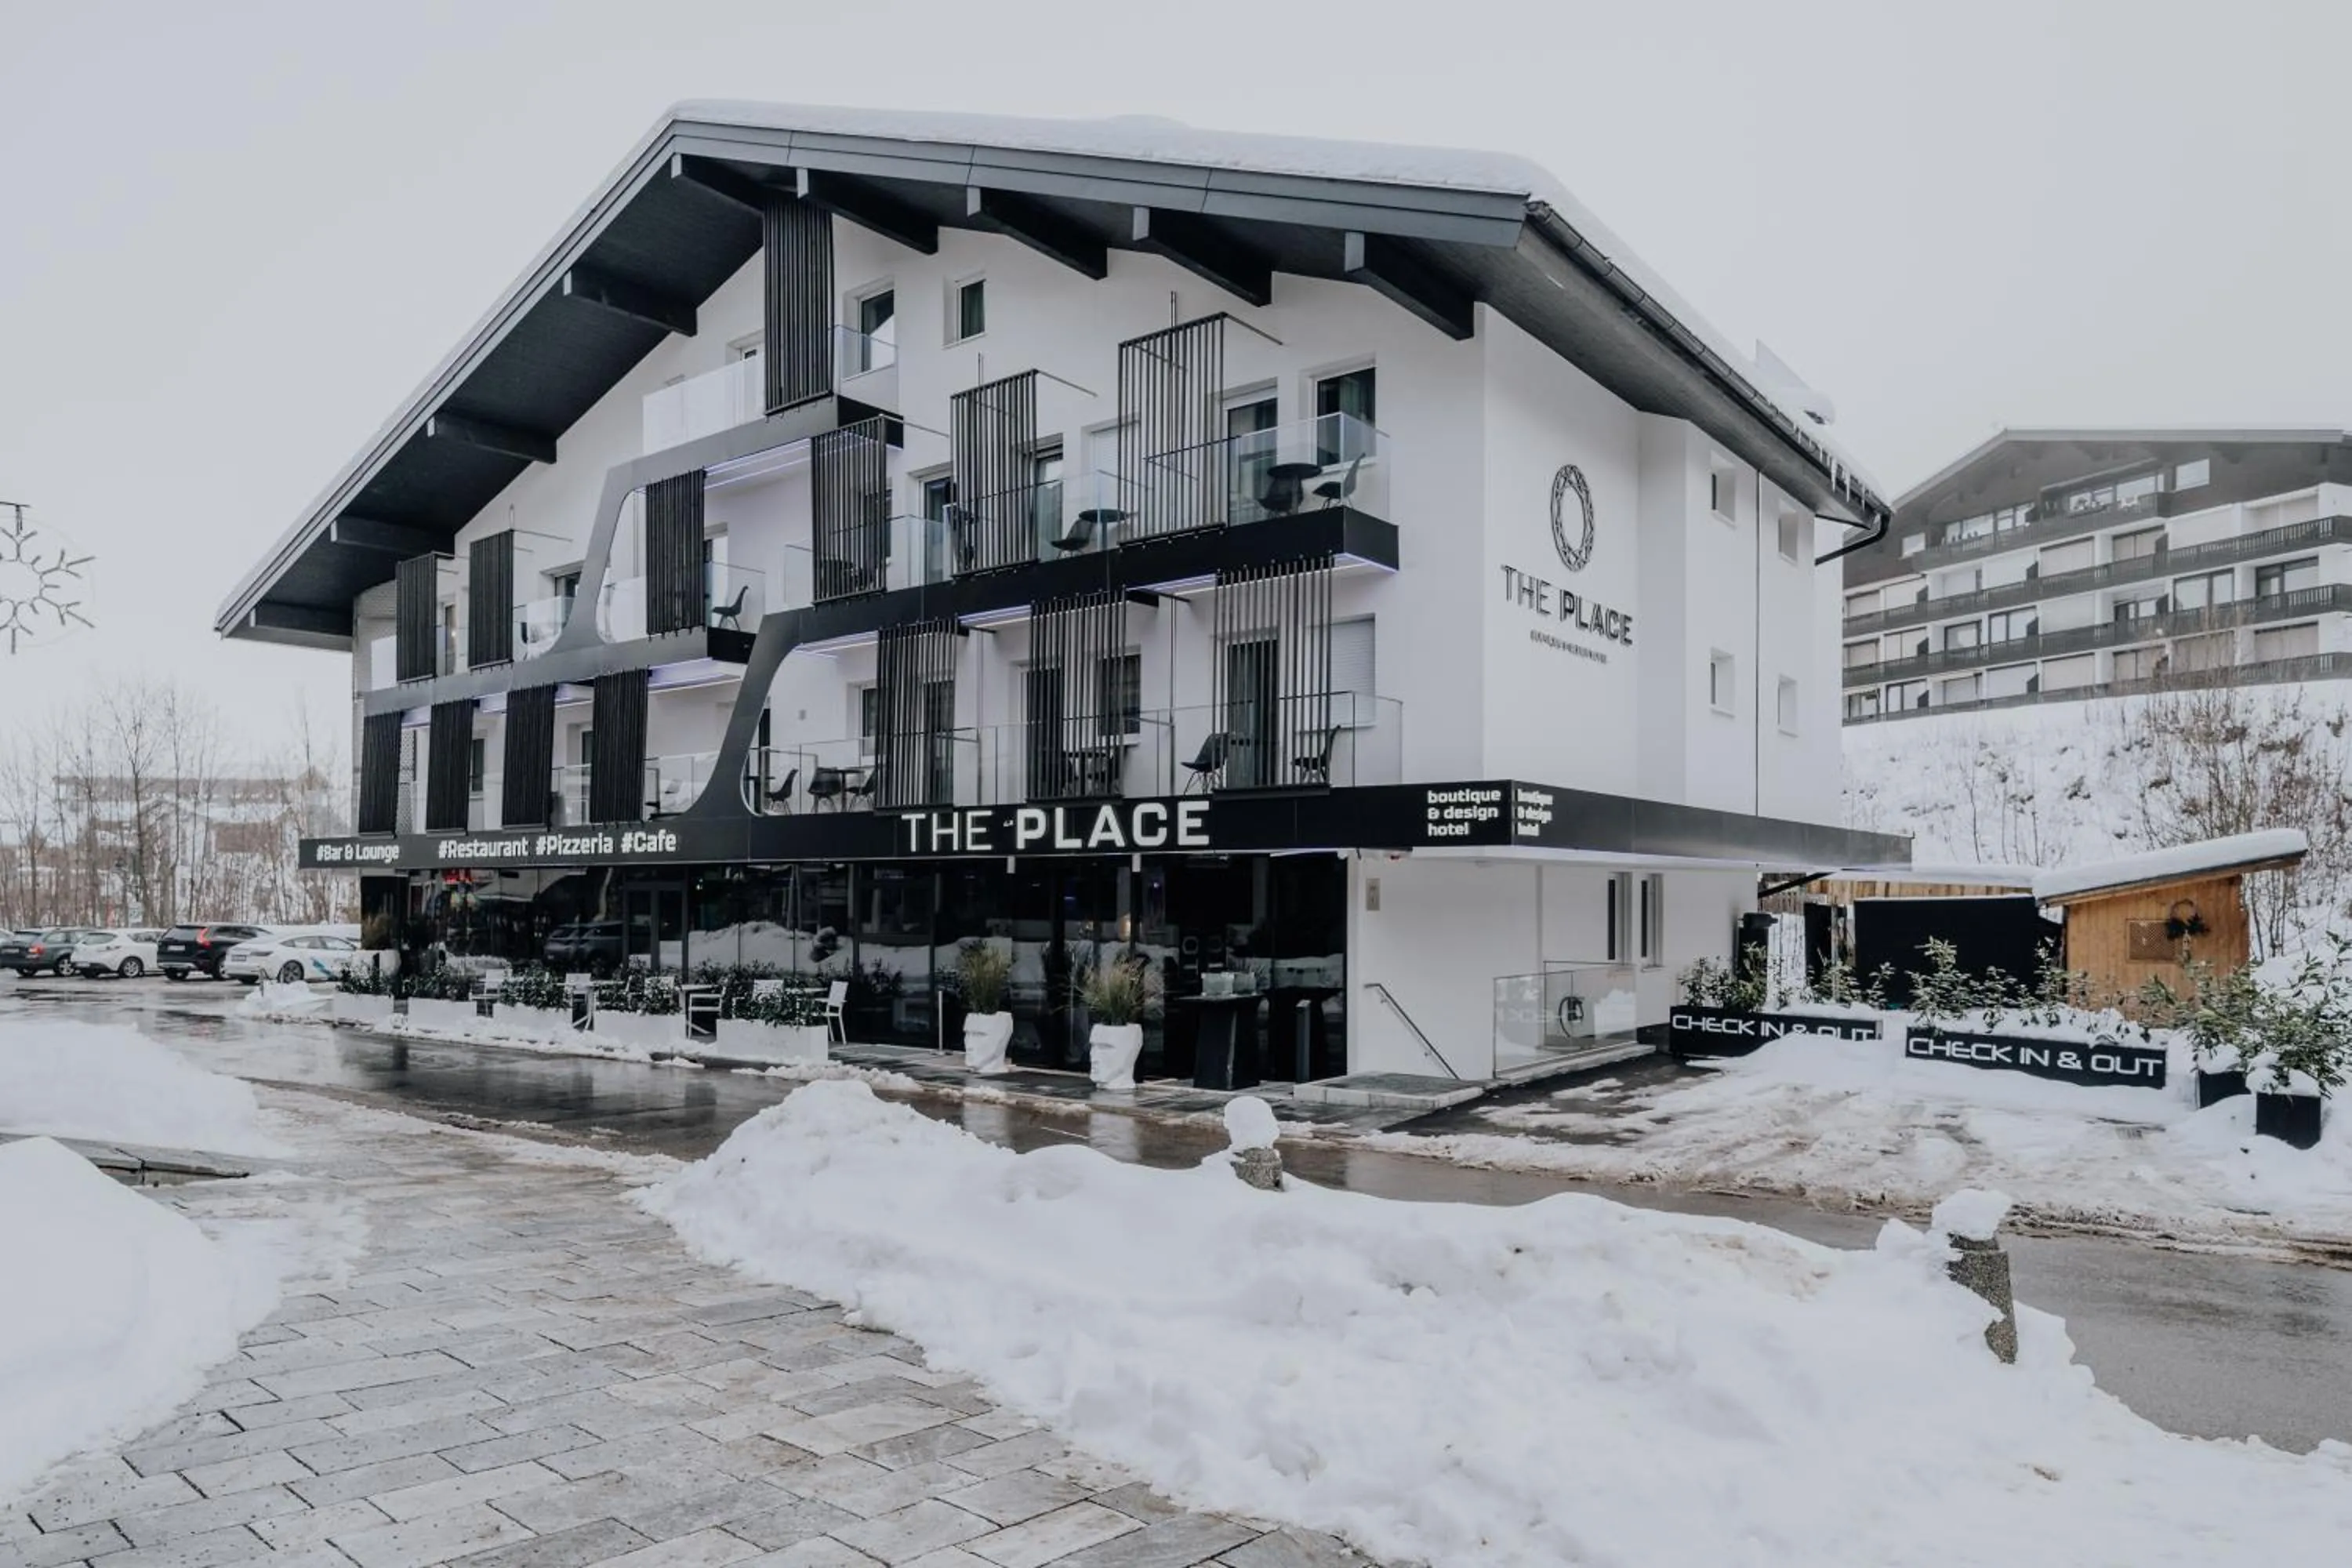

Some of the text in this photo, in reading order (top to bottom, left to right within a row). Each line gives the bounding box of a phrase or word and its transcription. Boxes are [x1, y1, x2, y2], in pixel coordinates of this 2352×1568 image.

[1501, 564, 1633, 646] THE PLACE
[1427, 789, 1501, 804] boutique
[1427, 805, 1499, 821] & design
[901, 800, 1210, 852] THE PLACE
[1427, 822, 1470, 837] hotel
[316, 844, 399, 863] #Bar & Lounge
[438, 829, 677, 858] #Restaurant #Pizzeria #Cafe
[1672, 1014, 1755, 1036] CHECK
[1760, 1022, 1785, 1038] IN
[1908, 1037, 2163, 1076] CHECK IN & OUT
